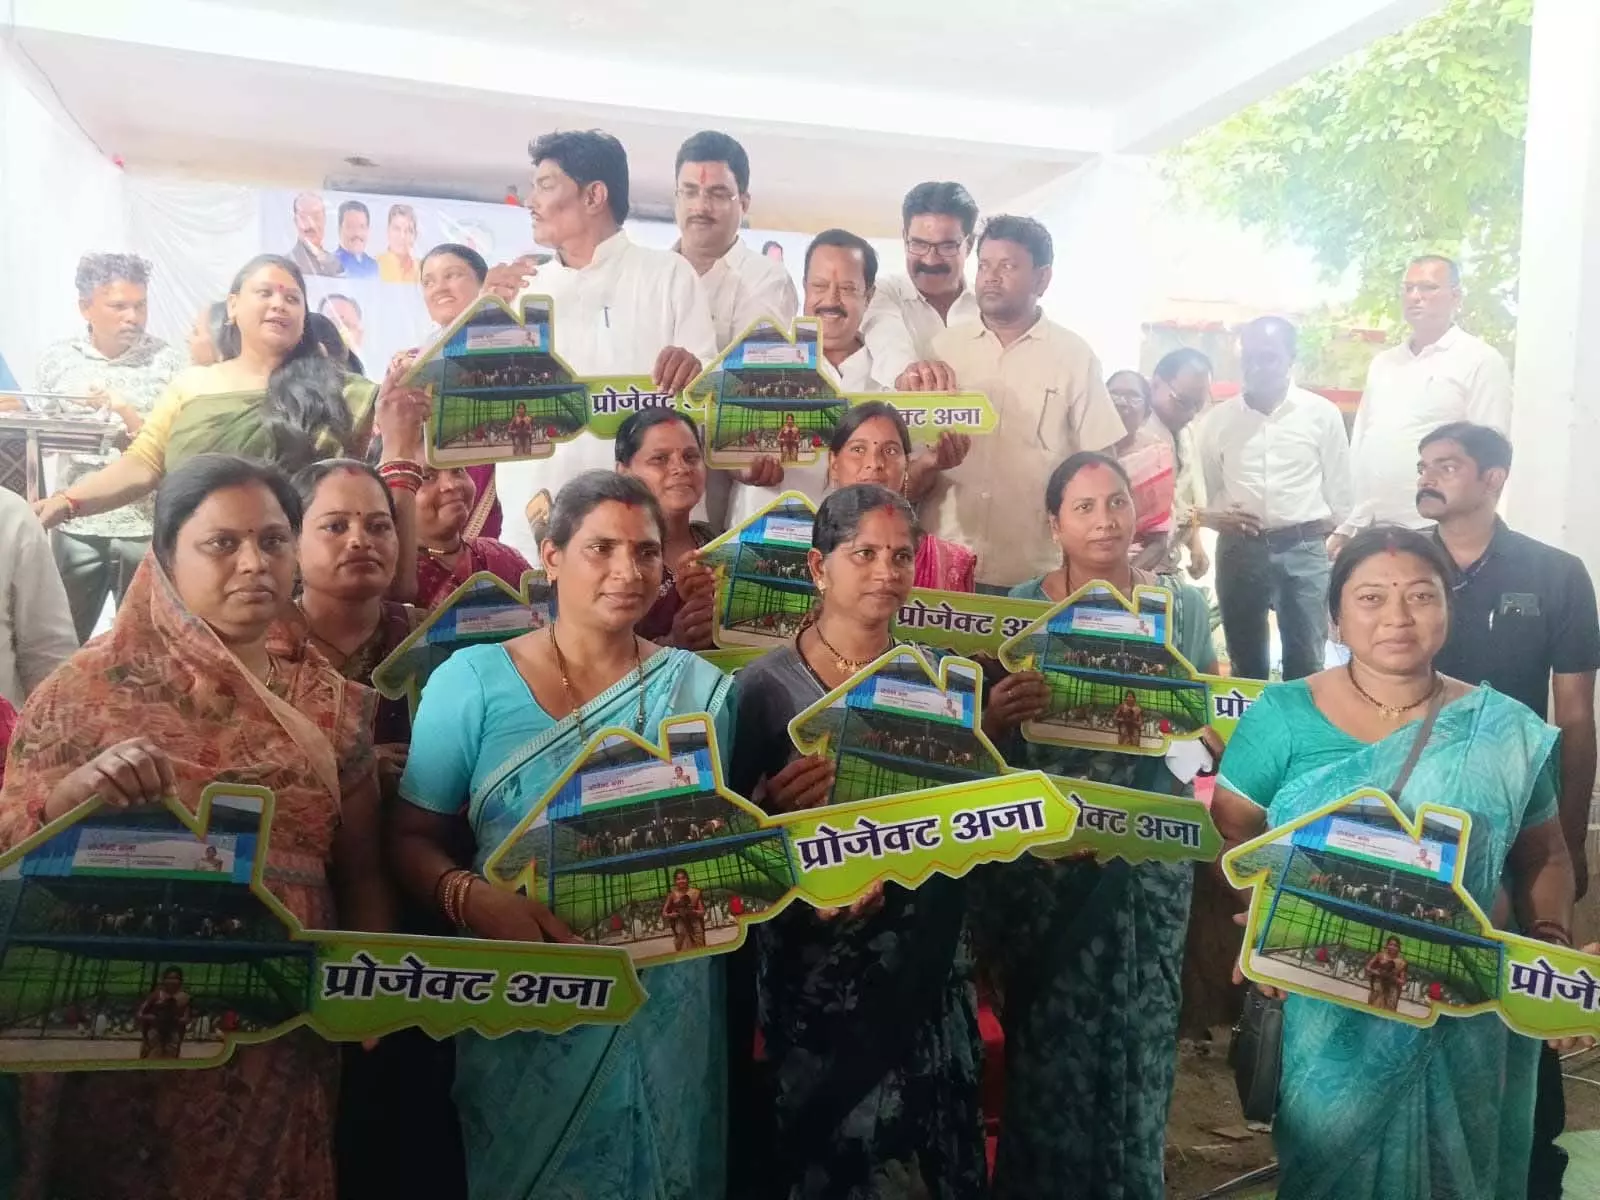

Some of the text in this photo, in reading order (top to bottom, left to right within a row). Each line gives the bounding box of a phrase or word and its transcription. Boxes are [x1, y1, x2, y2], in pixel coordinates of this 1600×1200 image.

[933, 408, 982, 425] अजा
[897, 599, 995, 634] प्रोजेक्ट
[796, 800, 1045, 871] प्रोजेक्ट अजा
[1135, 814, 1201, 847] अजा
[324, 952, 614, 1008] प्रोजेक्ट अजा
[1510, 958, 1600, 1010] प्रोजे
